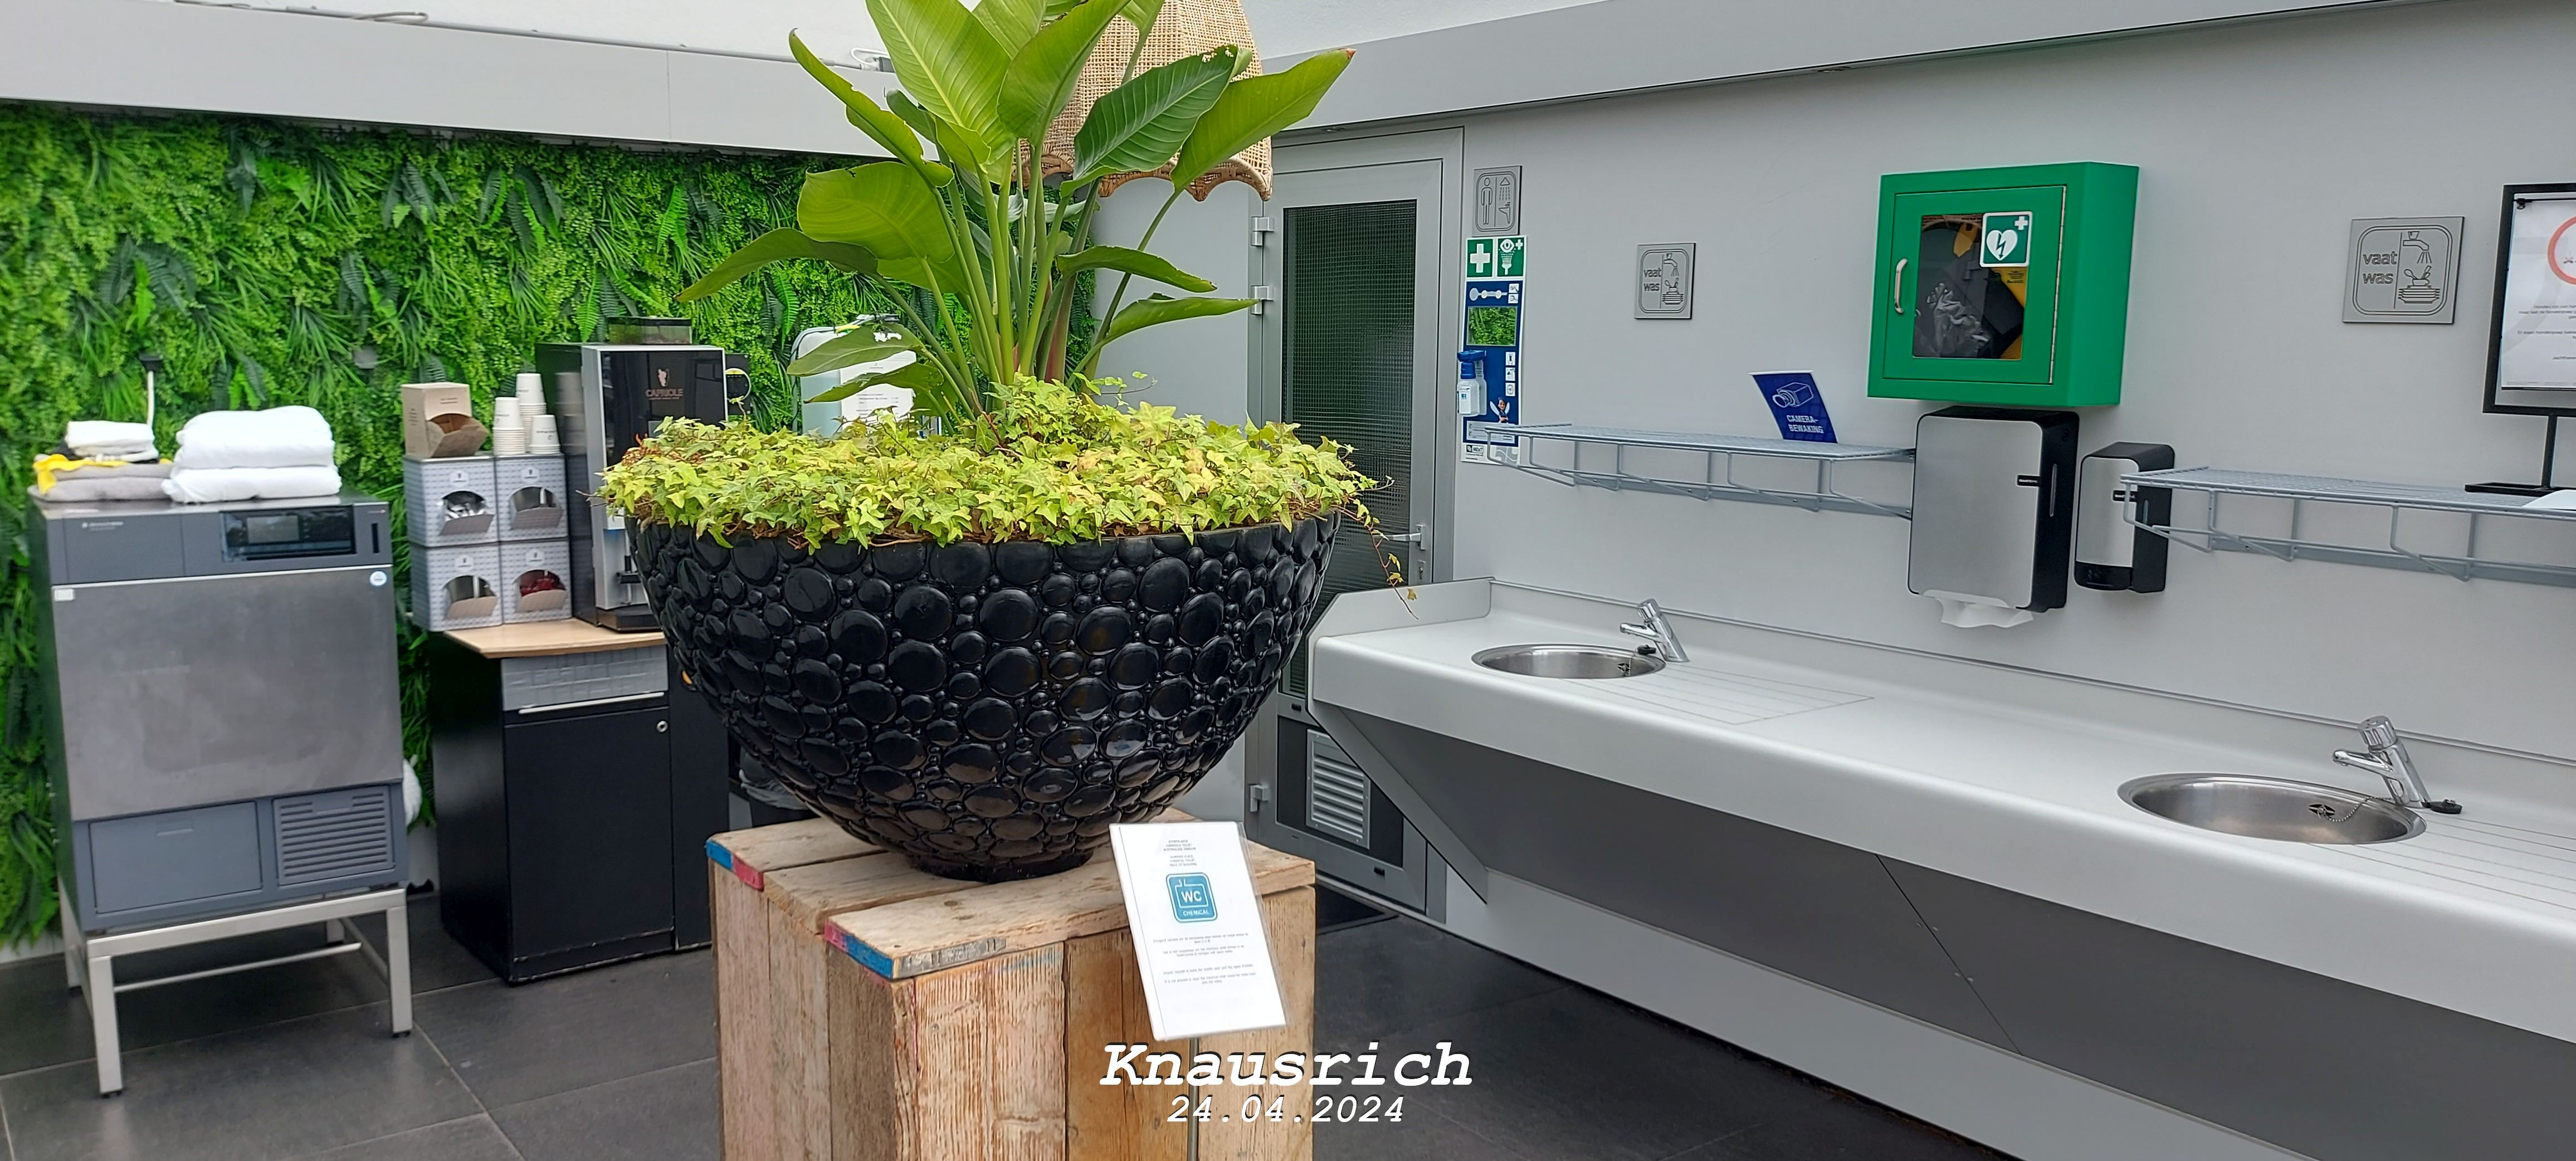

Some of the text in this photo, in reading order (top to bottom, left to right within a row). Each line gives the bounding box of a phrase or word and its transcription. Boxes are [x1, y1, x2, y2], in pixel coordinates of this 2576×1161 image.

[2363, 251, 2398, 265] vaat
[1643, 267, 1661, 277] vaat
[2363, 273, 2394, 284] was
[1643, 283, 1660, 291] was
[1786, 414, 1819, 423] CAMERA-
[1788, 423, 1825, 434] BEWAKING
[1181, 890, 1202, 903] WC
